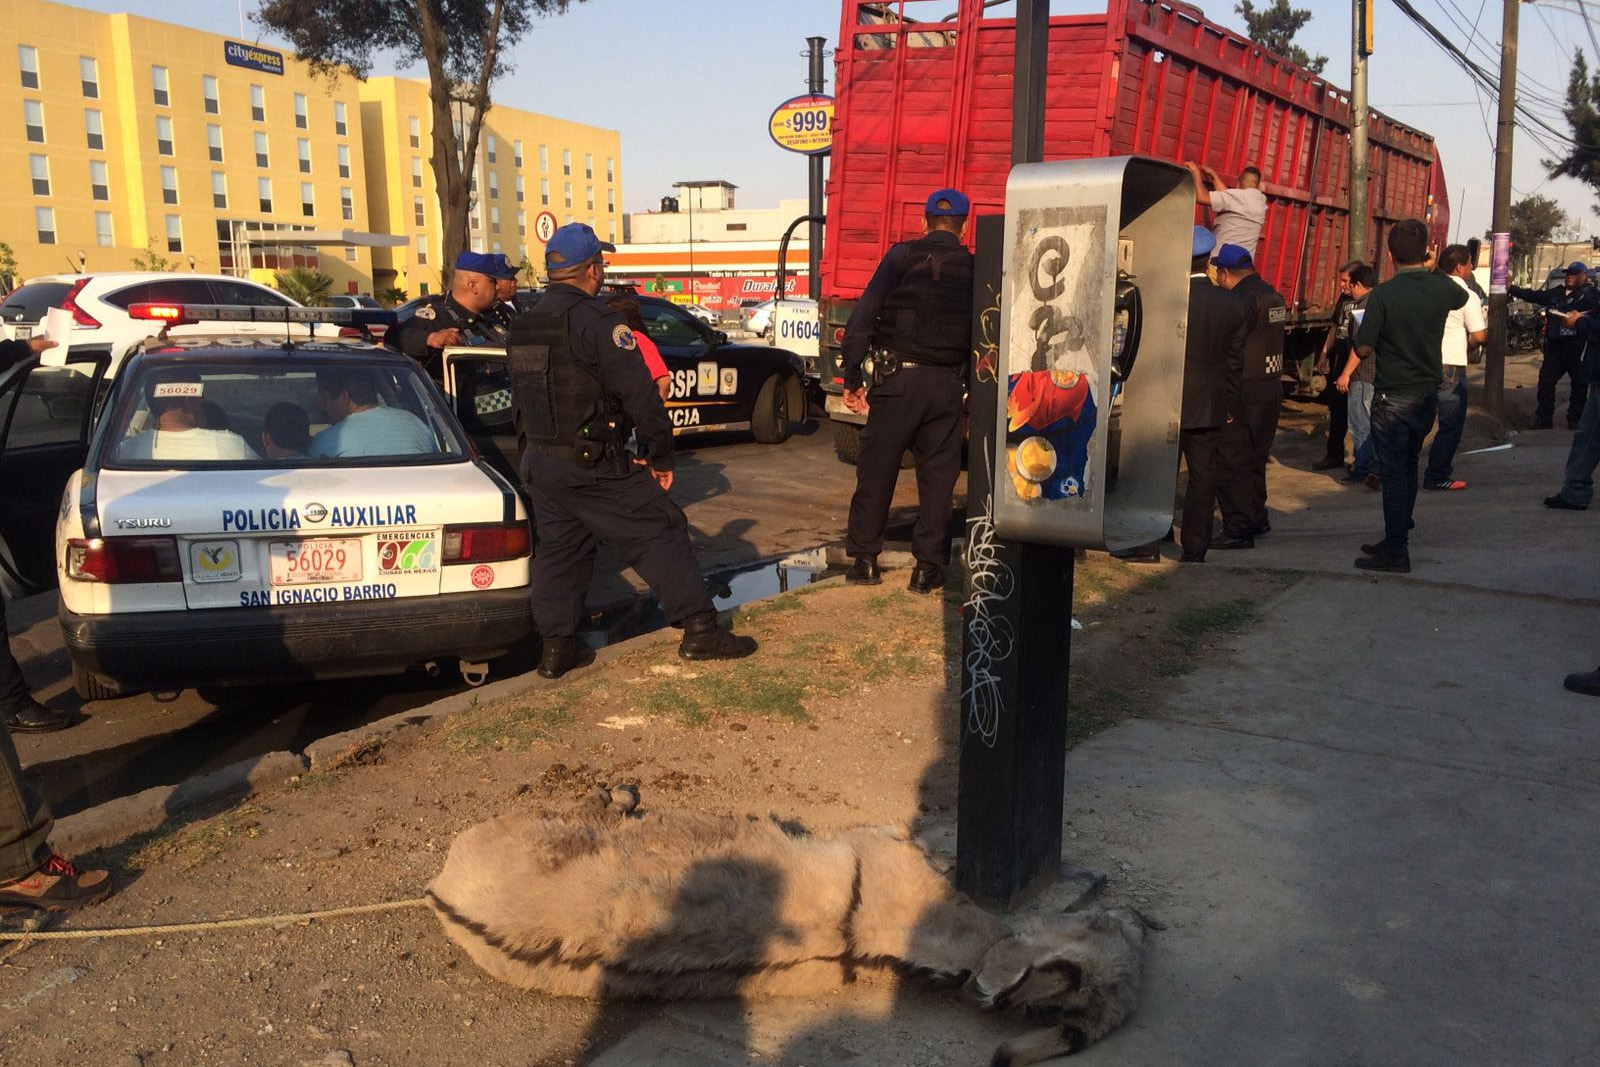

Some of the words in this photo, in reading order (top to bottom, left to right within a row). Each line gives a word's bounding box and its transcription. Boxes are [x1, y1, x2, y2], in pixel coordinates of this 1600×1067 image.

[781, 319, 820, 340] 01604
[159, 386, 198, 395] 56029
[114, 518, 171, 529] TSURU
[222, 508, 302, 532] POLICIA
[331, 504, 417, 527] AUXILIAR
[376, 532, 435, 541] EMERGENCIAS
[298, 542, 334, 550] POLICIA
[287, 549, 347, 572] 56029
[240, 589, 271, 607] SAN
[276, 587, 338, 605] IGNACIO
[343, 583, 397, 600] BARRIO
